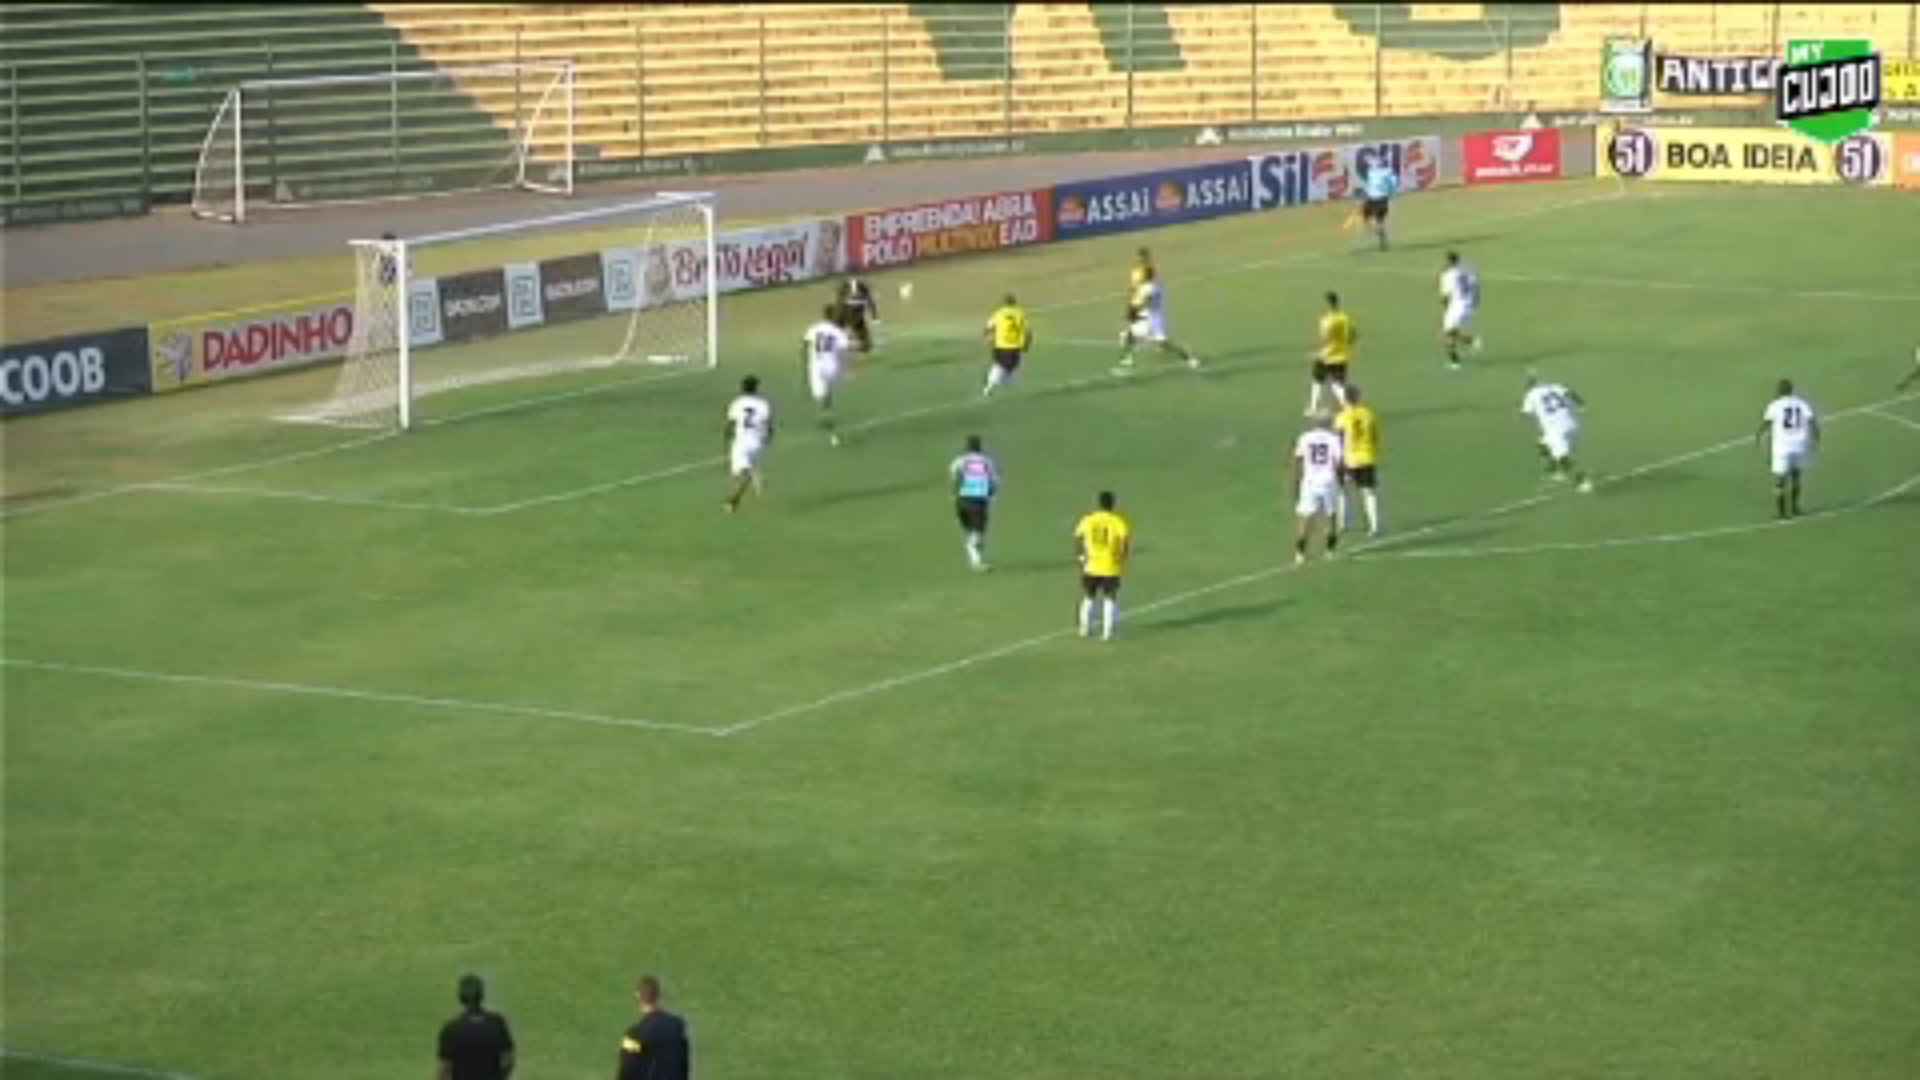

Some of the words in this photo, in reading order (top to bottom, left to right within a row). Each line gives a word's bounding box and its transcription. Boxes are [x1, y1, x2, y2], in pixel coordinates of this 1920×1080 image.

[1616, 133, 1646, 174] 51
[1667, 143, 1732, 169] BOA
[1743, 143, 1818, 172] IDEIA
[1842, 138, 1874, 179] 51
[203, 306, 354, 371] DADINHO
[1783, 406, 1802, 429] 21
